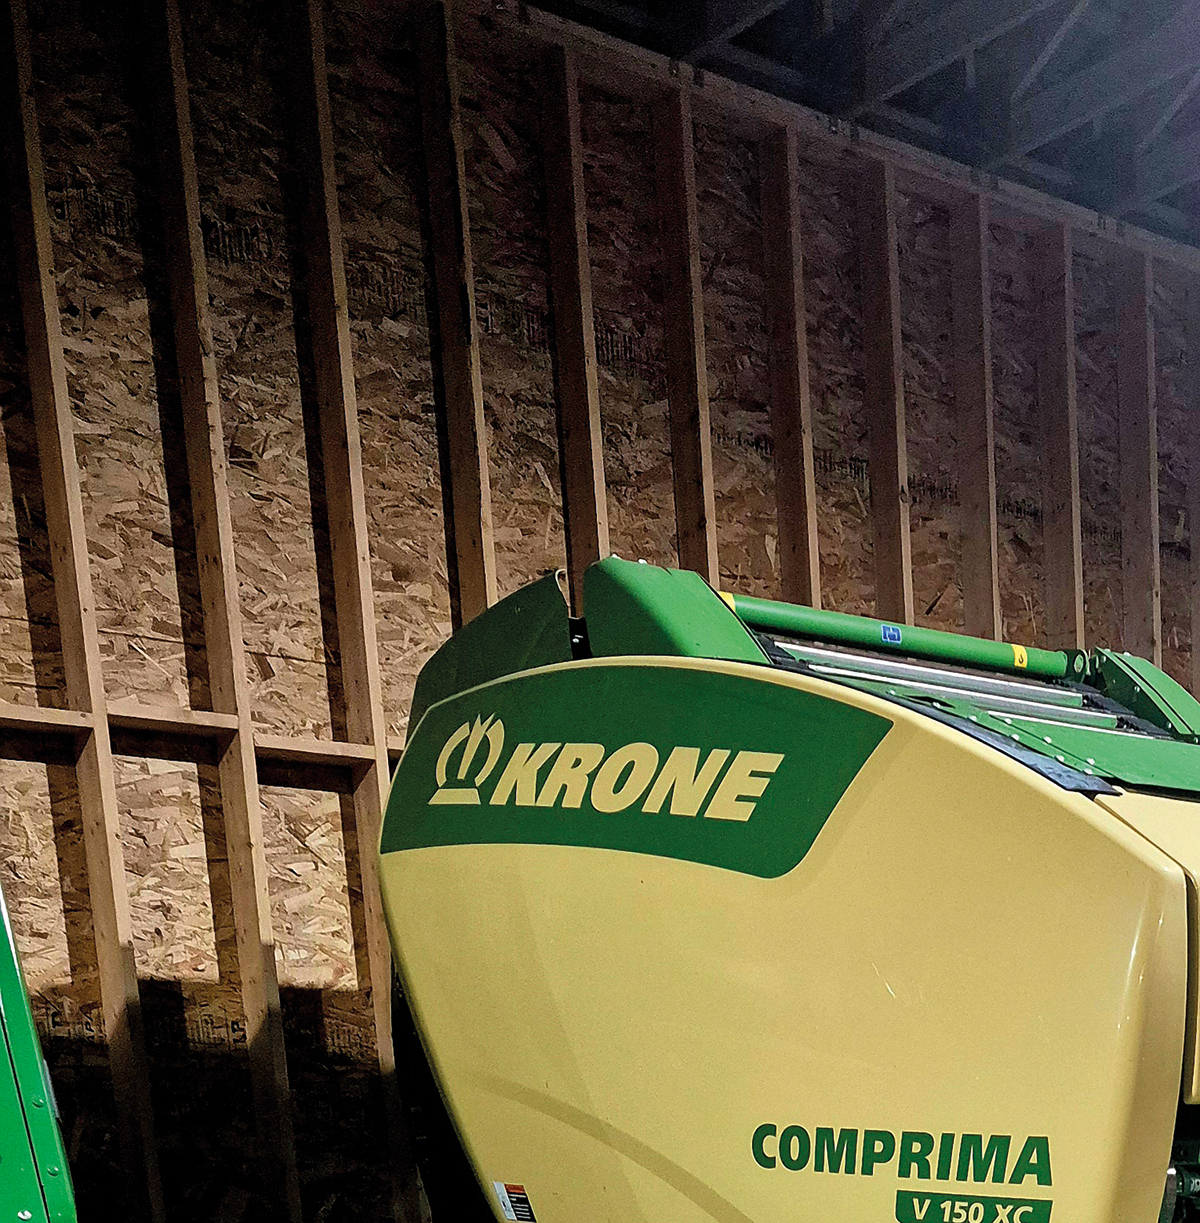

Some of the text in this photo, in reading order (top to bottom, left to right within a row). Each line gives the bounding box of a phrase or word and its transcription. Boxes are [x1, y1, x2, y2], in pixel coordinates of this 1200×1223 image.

[489, 742, 785, 822] KRONE
[752, 1123, 1053, 1186] COMPRIMA
[912, 1198, 931, 1220] V
